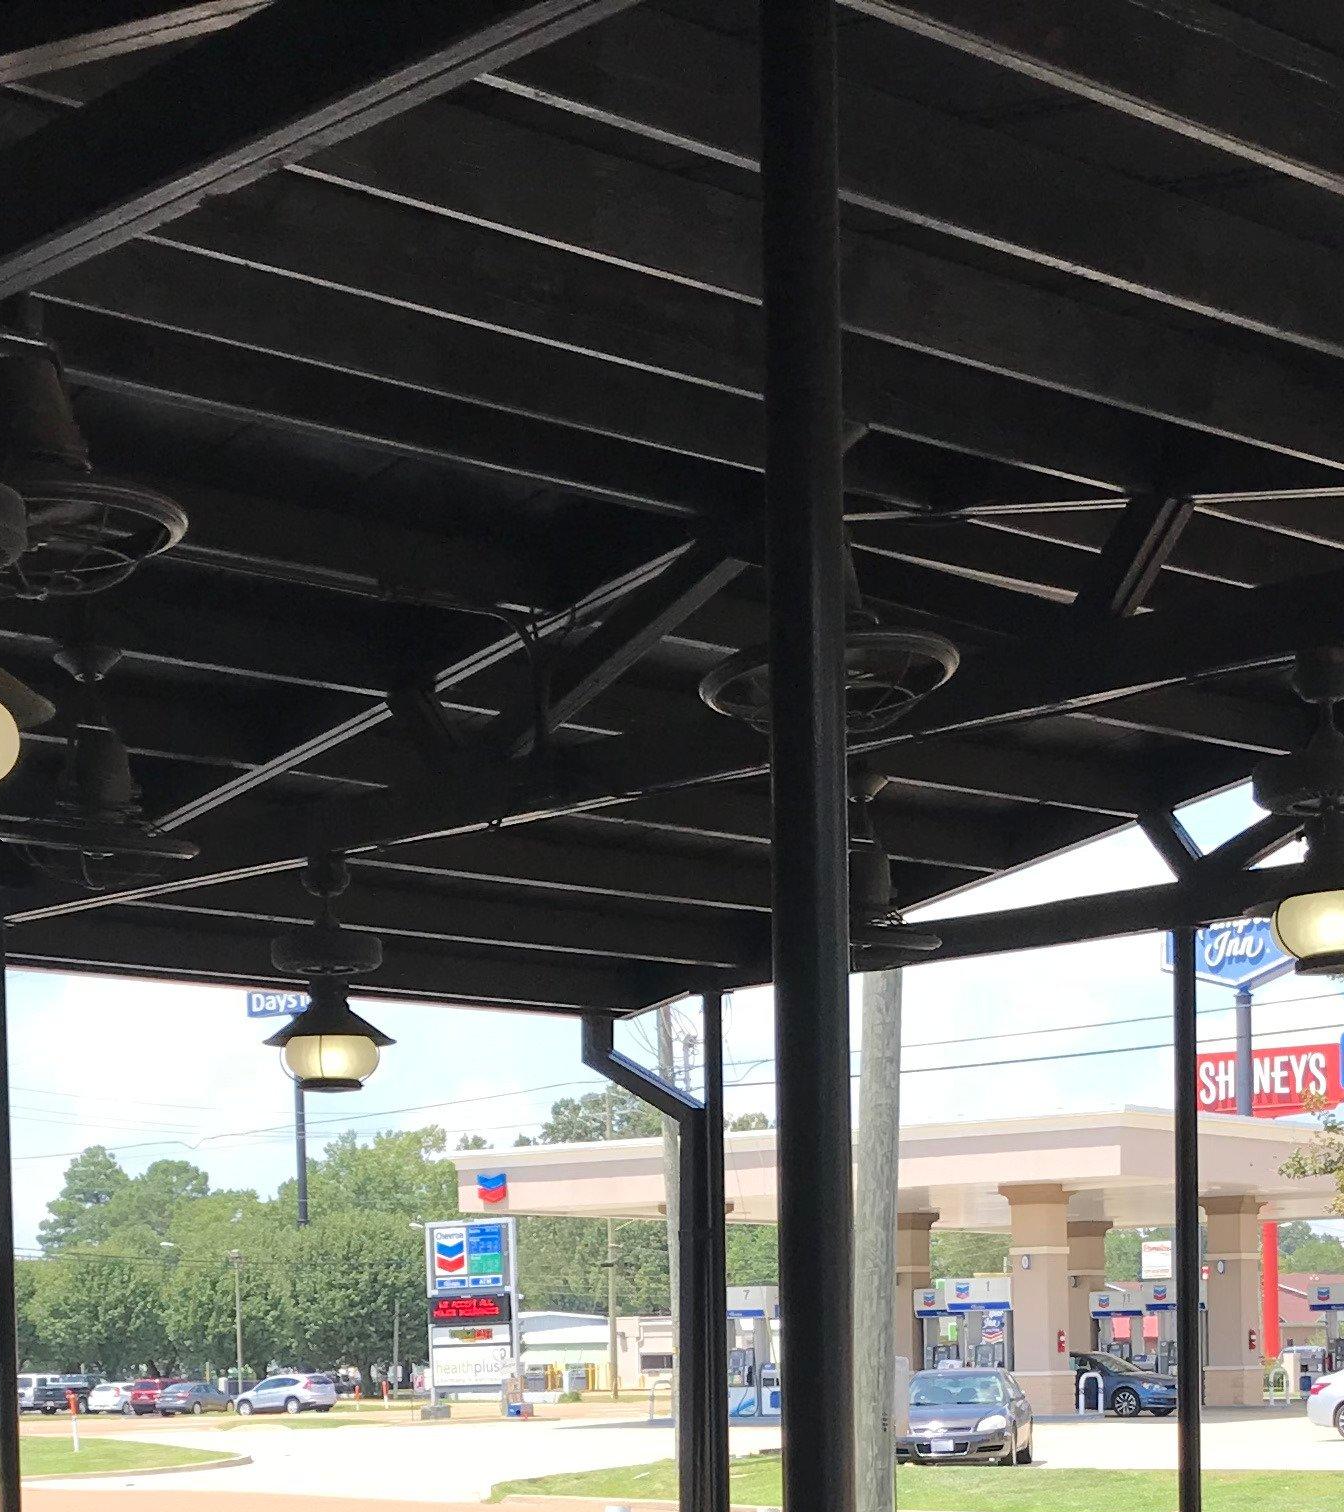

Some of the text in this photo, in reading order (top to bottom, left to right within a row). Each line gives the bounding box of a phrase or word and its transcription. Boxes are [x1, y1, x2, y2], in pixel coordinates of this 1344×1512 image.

[1206, 930, 1264, 967] Inn
[251, 993, 297, 1013] Days
[1199, 1052, 1327, 1105] SHNEY'S
